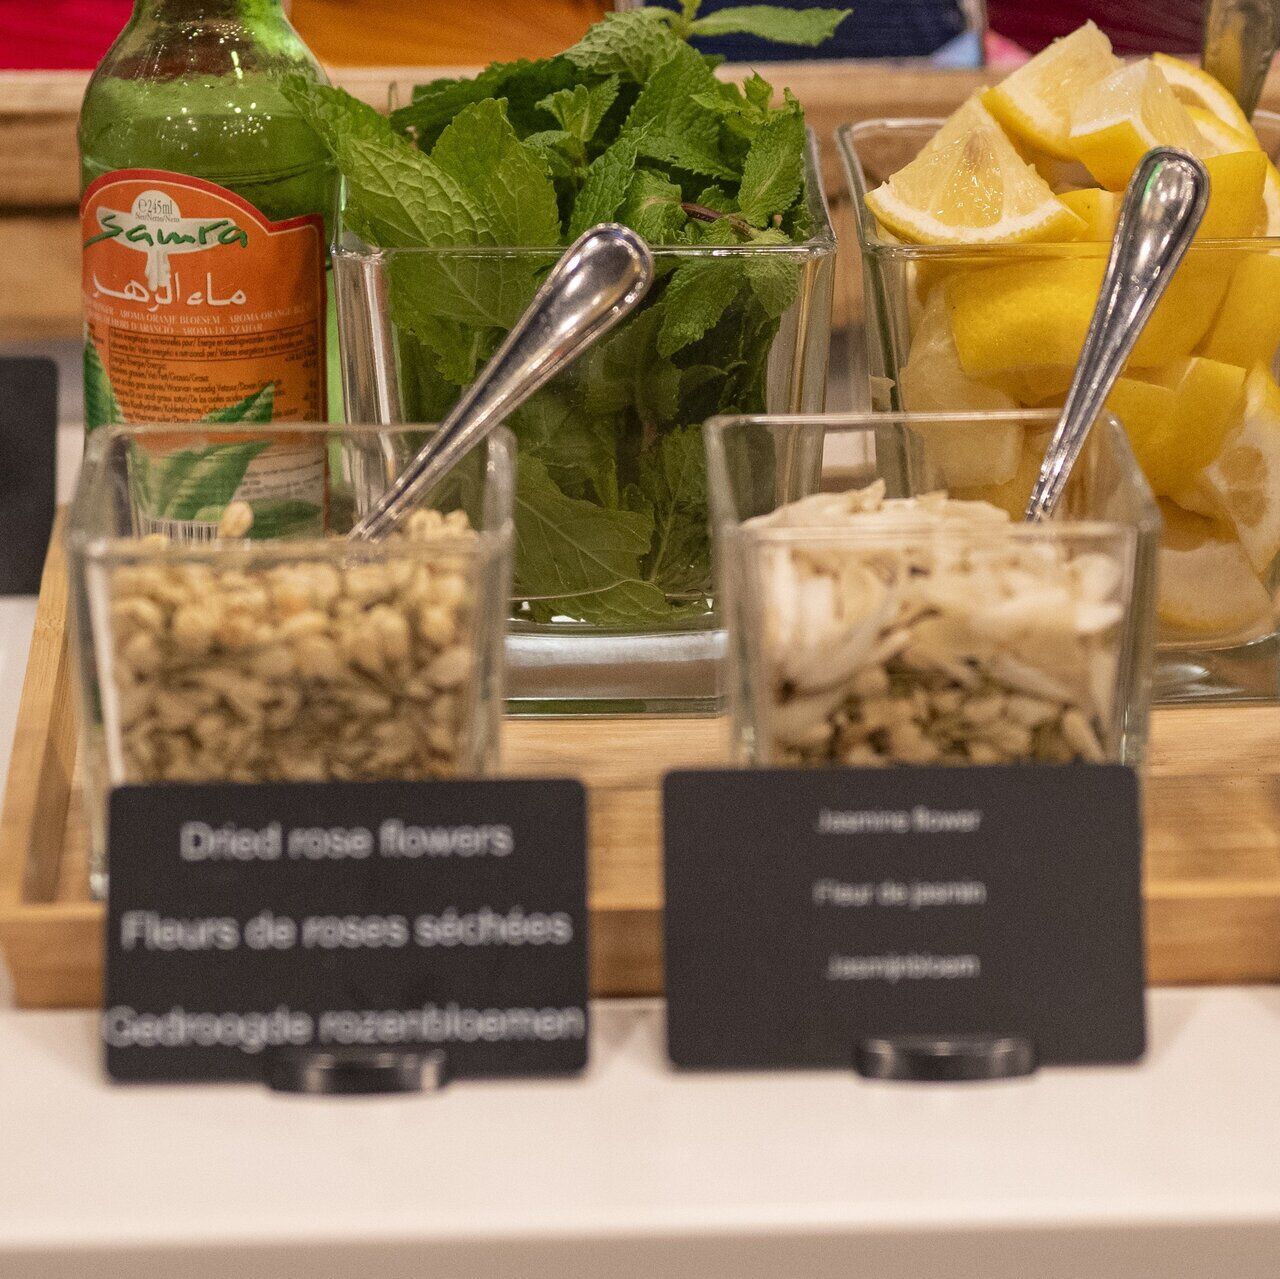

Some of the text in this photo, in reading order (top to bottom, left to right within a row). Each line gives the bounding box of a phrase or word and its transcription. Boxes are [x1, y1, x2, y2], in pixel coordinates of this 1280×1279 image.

[84, 214, 248, 249] Samra
[179, 819, 515, 861] Dried rose flowers
[120, 910, 240, 952] Fleurs
[244, 909, 298, 950] de
[301, 914, 410, 949] roses
